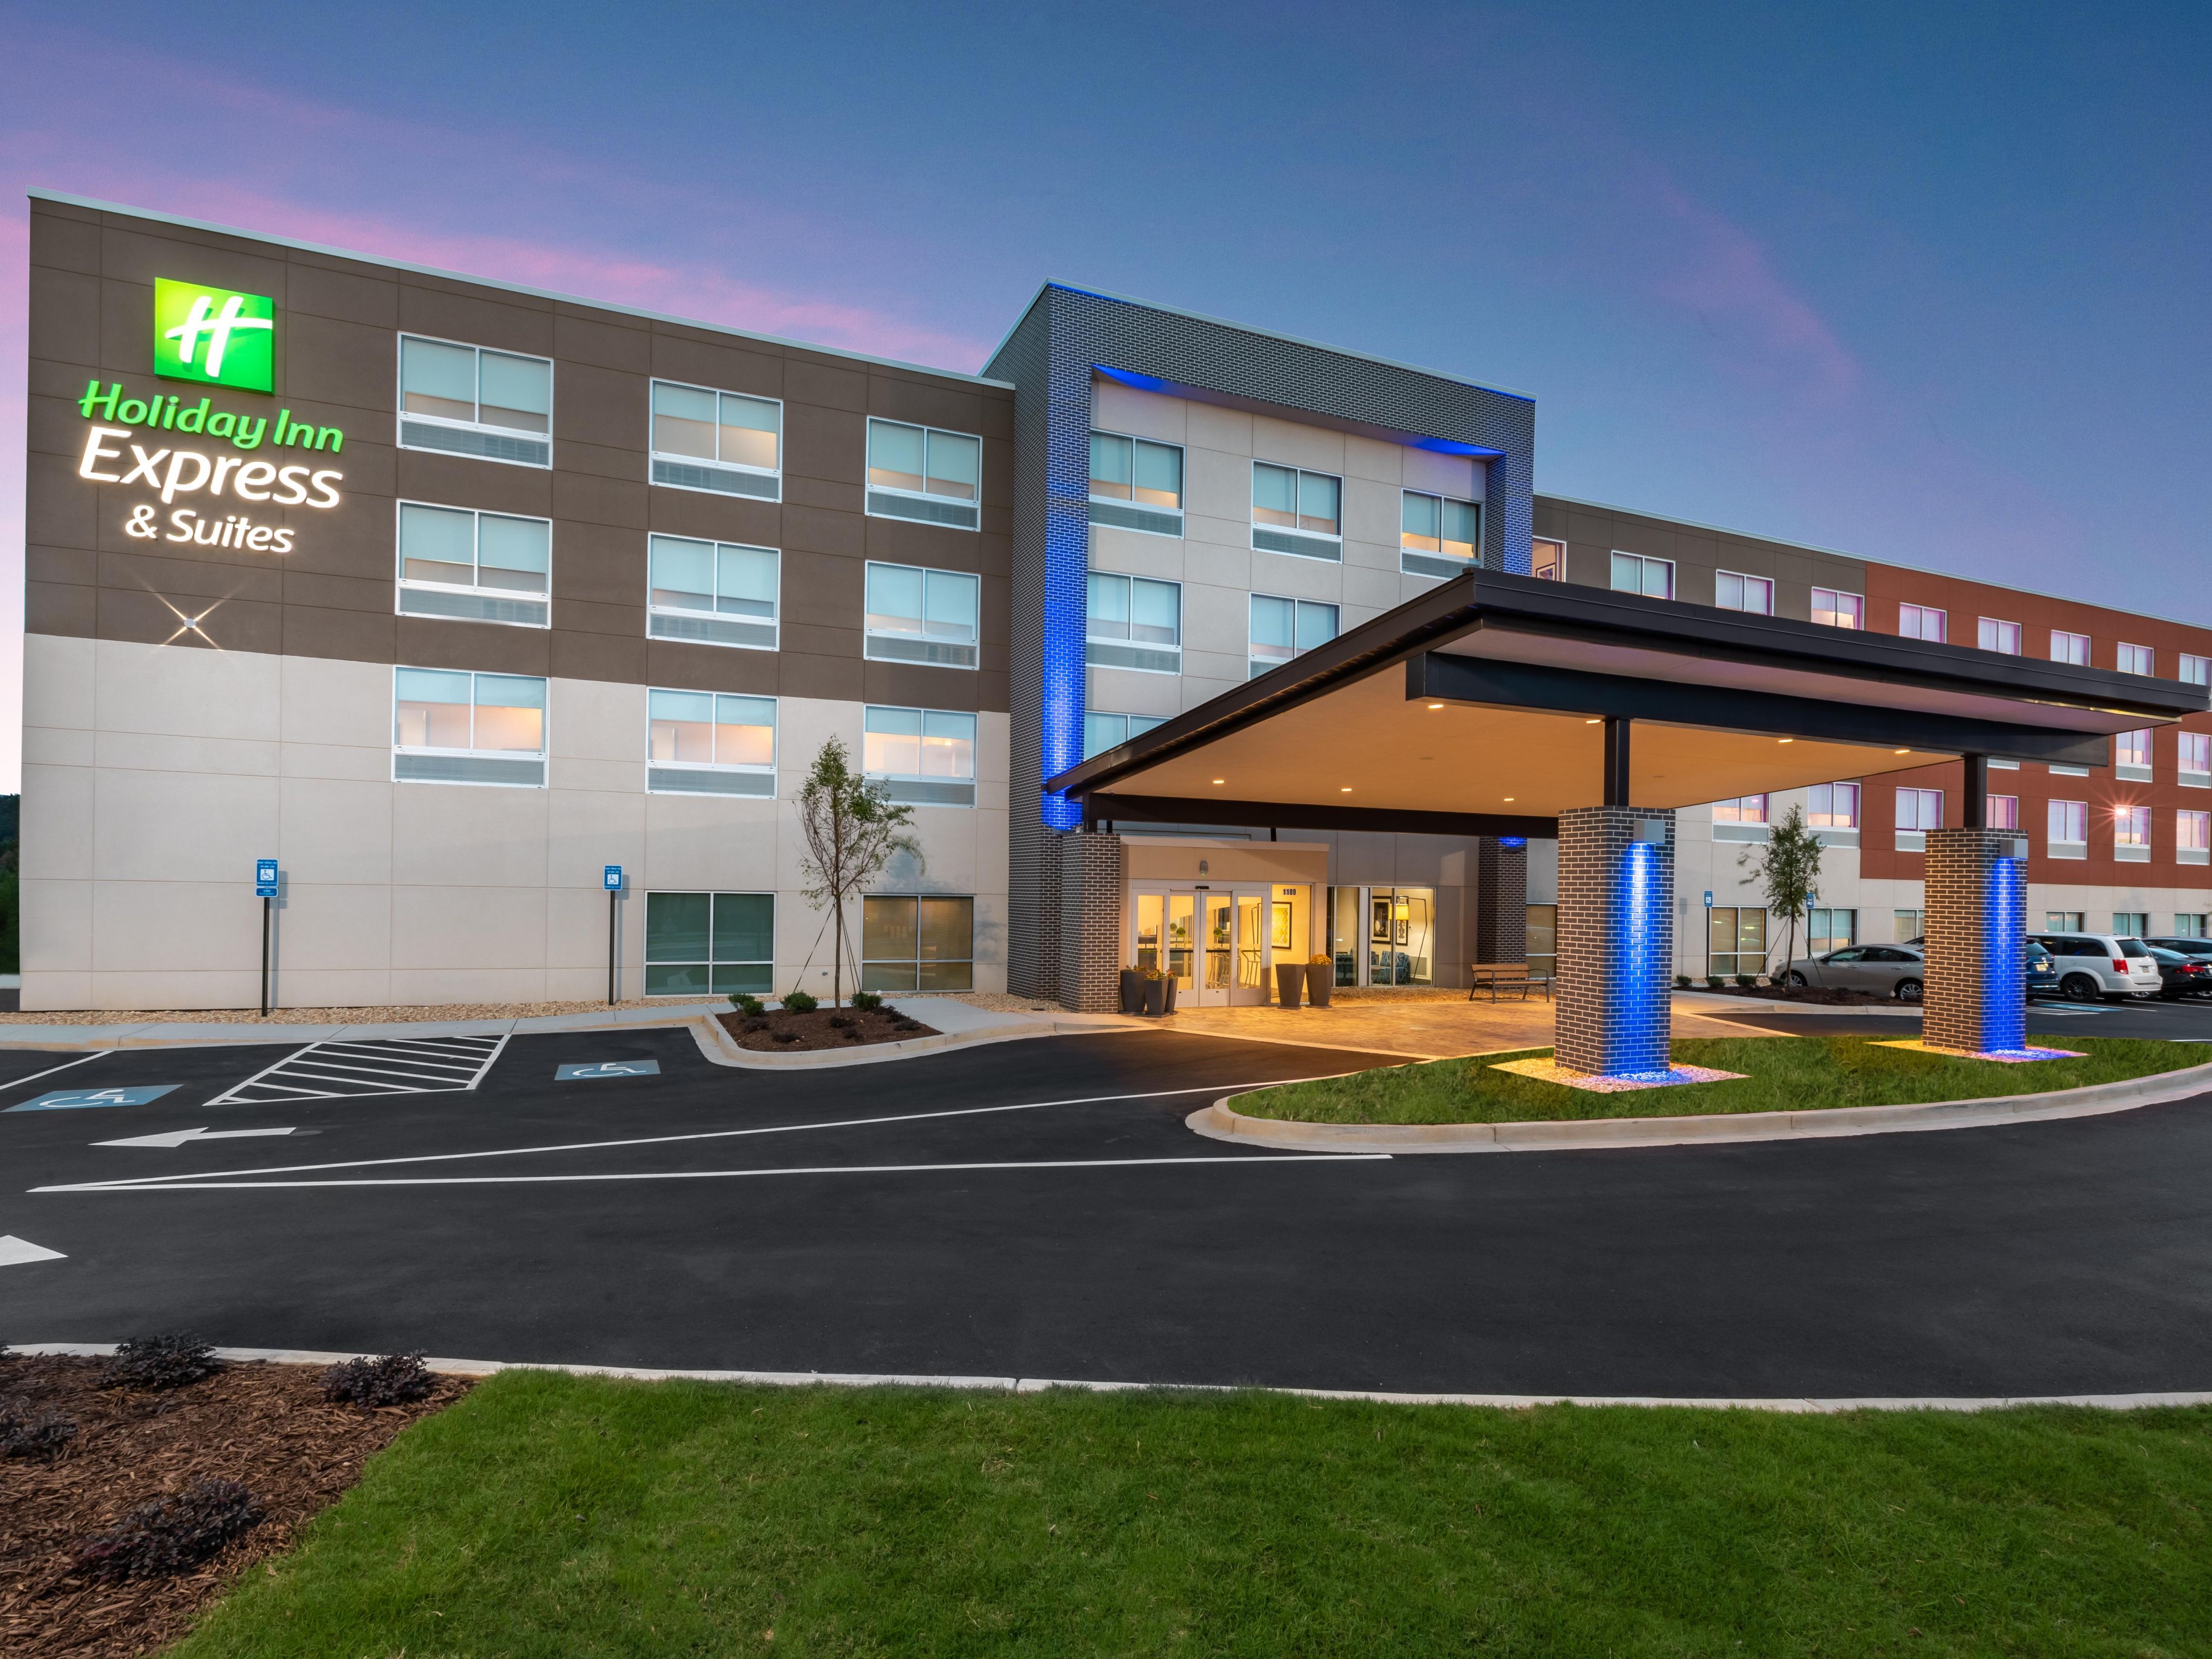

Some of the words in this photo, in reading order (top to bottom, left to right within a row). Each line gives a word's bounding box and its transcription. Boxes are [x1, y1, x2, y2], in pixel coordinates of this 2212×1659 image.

[78, 380, 267, 449] Holiday
[273, 409, 343, 453] Inn
[79, 426, 343, 508] Express
[125, 505, 157, 539] &
[166, 510, 294, 552] Suites
